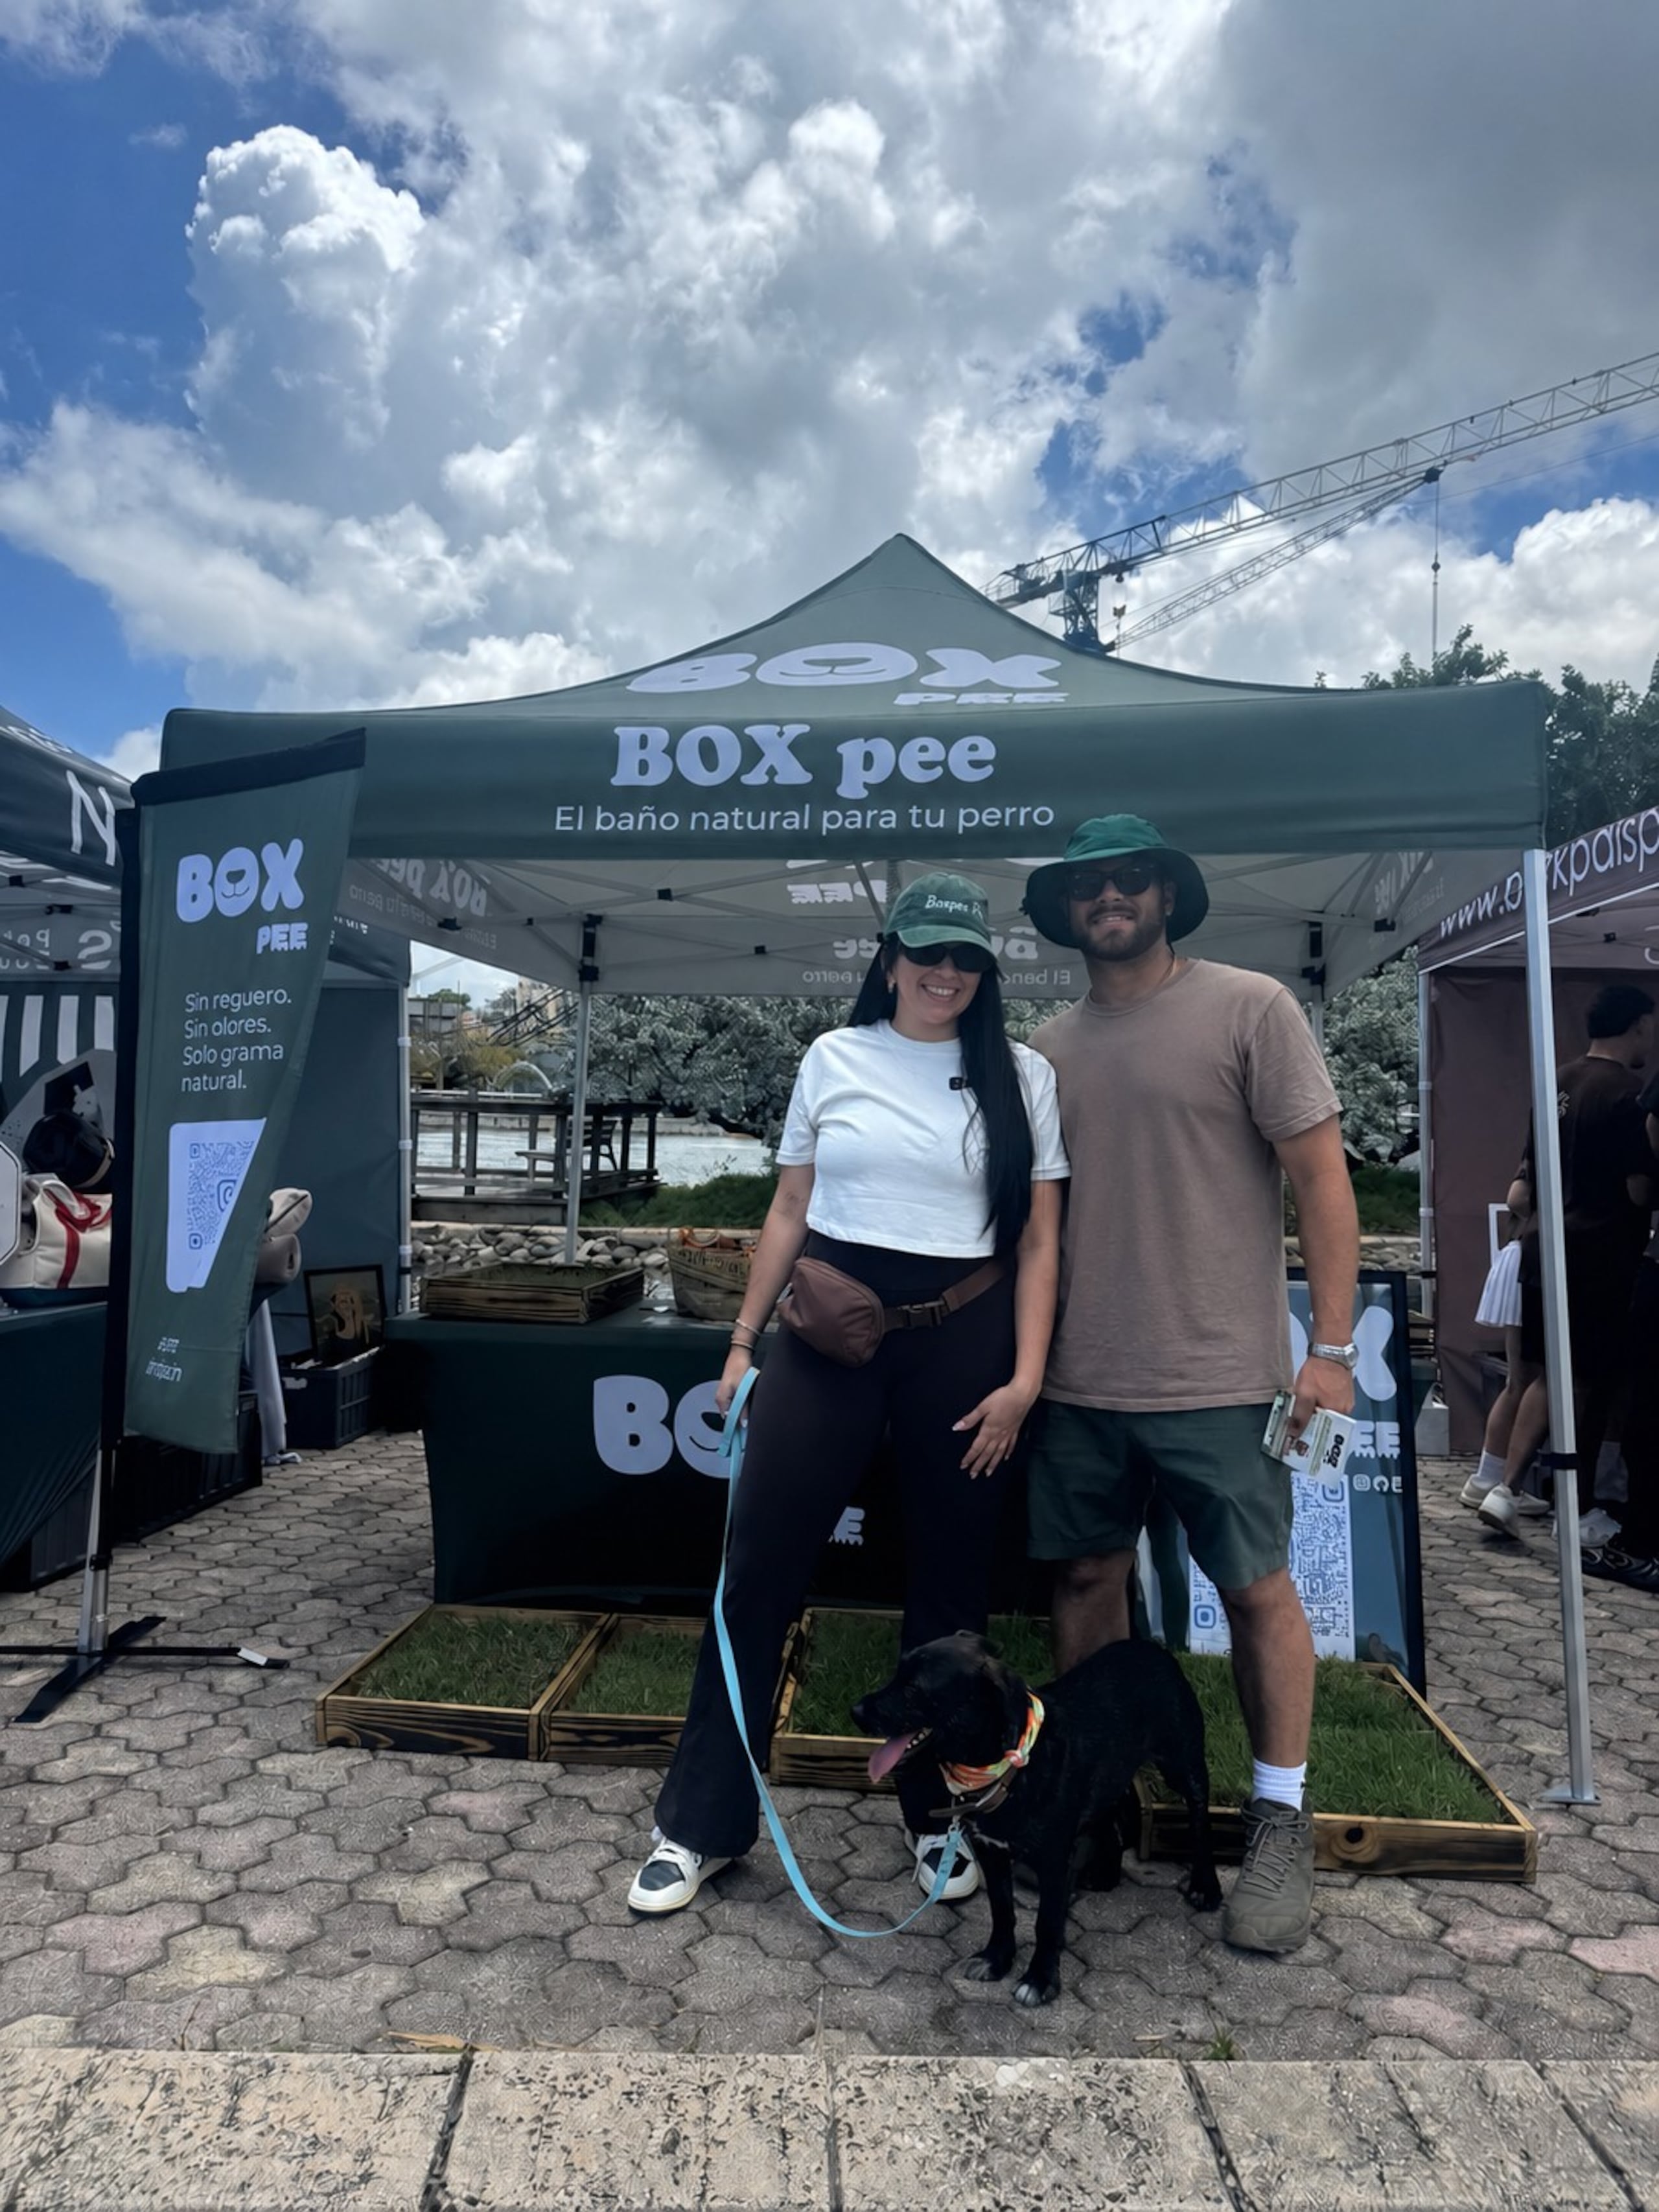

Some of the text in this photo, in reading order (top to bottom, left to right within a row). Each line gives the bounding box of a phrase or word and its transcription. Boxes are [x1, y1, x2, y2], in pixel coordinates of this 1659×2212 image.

[625, 642, 1062, 693] BOX
[893, 692, 1070, 706] PEE
[610, 724, 997, 799] BOX pee
[555, 804, 1054, 835] El baño natural para tu perro
[176, 839, 305, 924] BOX
[256, 922, 308, 954] PEE
[185, 989, 292, 1013] Sin reguero.
[184, 1016, 272, 1040] Sin olores.
[183, 1044, 284, 1068] Solo grama
[181, 1069, 246, 1092] natural.
